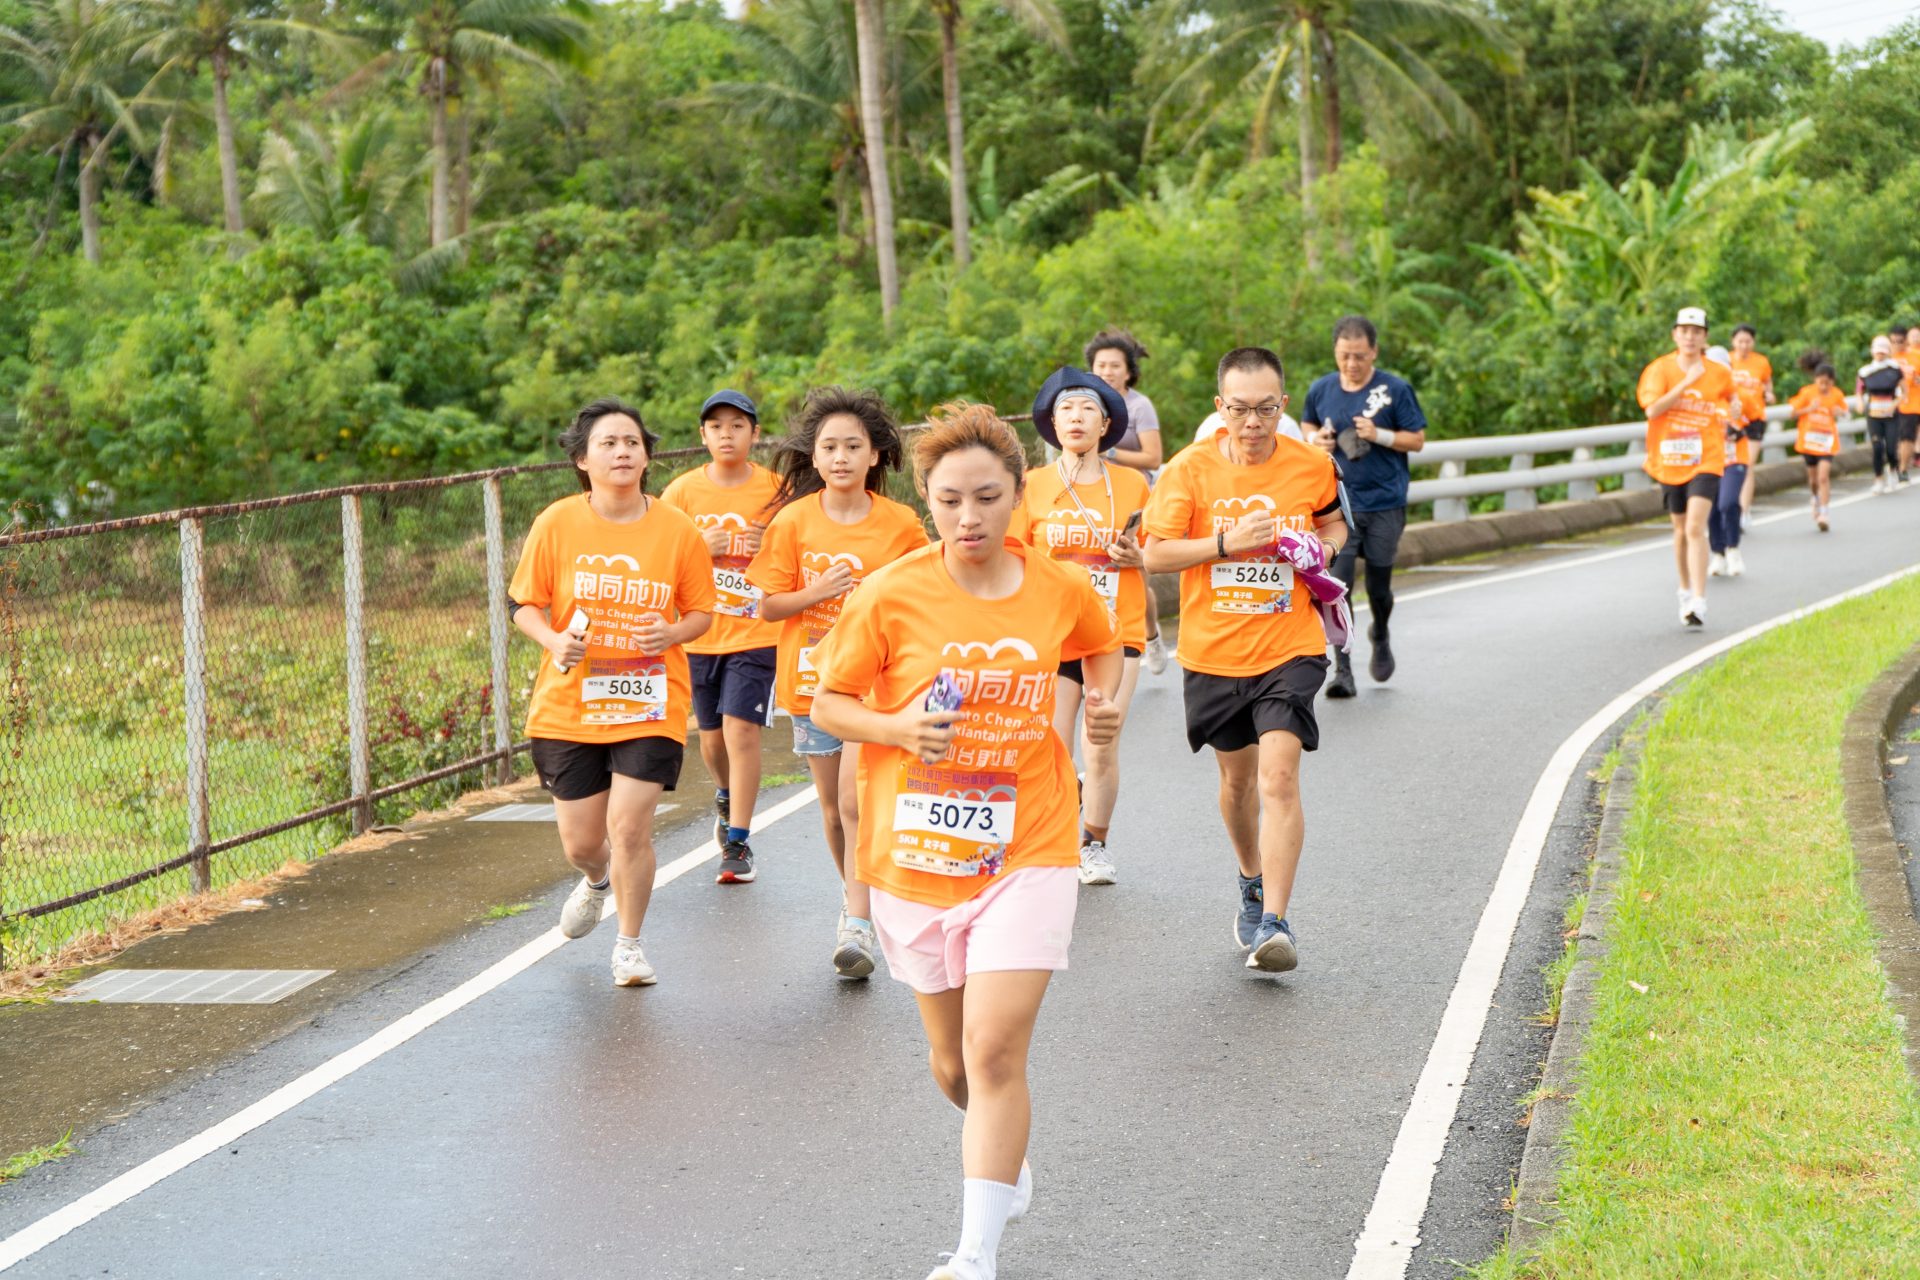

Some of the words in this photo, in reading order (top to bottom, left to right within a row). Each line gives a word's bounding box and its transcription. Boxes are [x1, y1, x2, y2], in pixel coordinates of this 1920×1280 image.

[1089, 573, 1107, 588] 04
[1235, 567, 1280, 583] 5266
[608, 679, 653, 696] 5036
[928, 802, 994, 831] 5073
